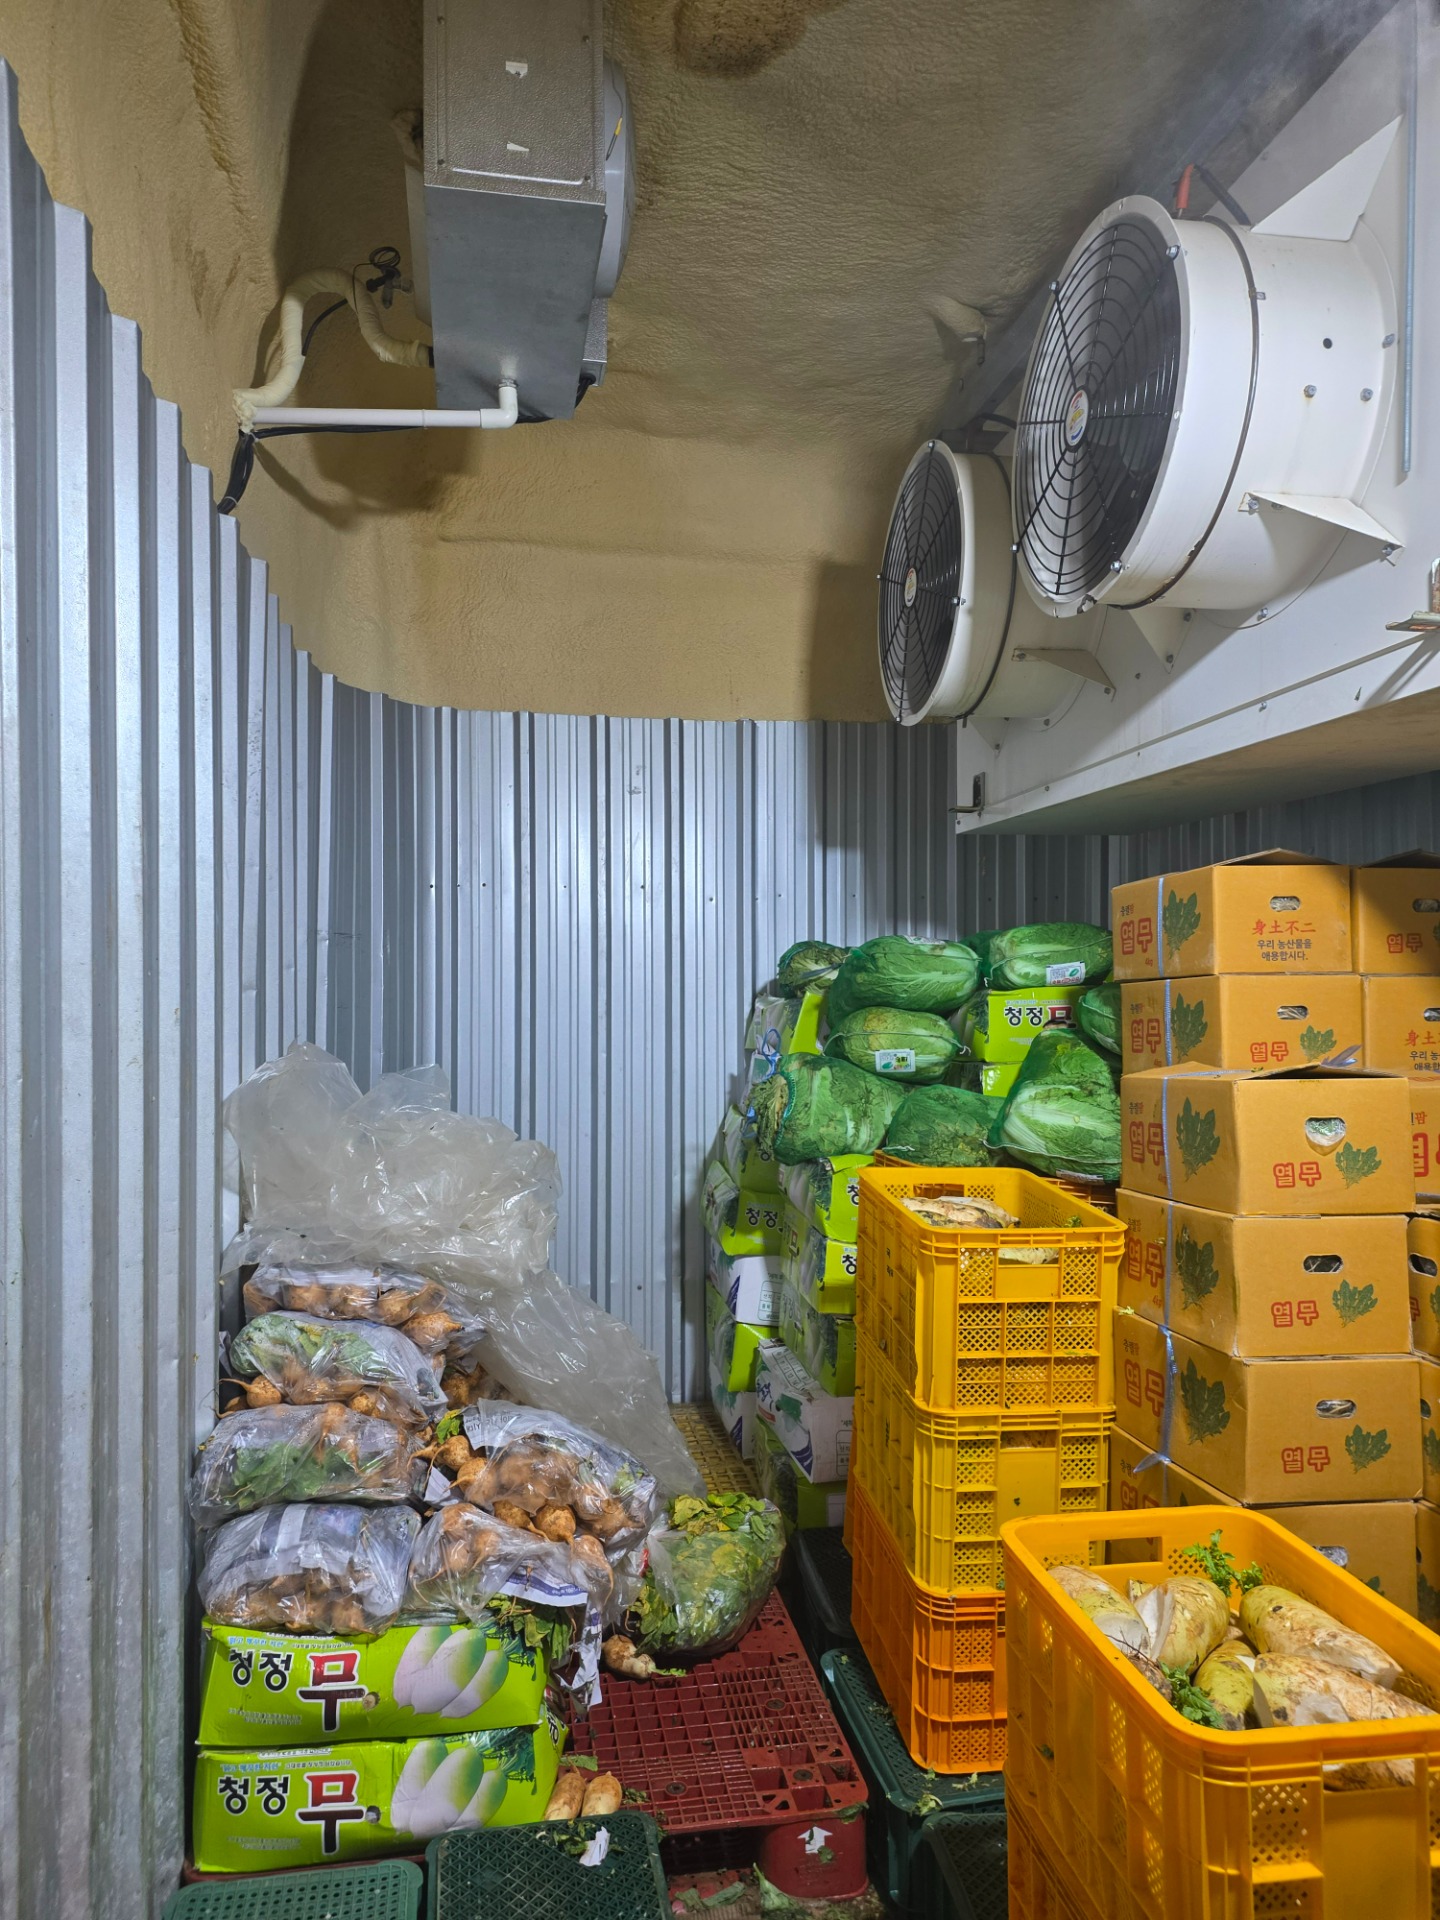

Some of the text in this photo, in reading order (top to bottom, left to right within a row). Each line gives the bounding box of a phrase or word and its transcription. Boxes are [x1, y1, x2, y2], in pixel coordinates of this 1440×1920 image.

[1121, 917, 1153, 955] 열무
[1252, 919, 1316, 936] 身土不二
[1257, 938, 1313, 950] 우리 농산물을
[1261, 950, 1309, 961] 애용합시다.
[1387, 933, 1424, 954] 열무
[1004, 1006, 1043, 1026] 청정
[1131, 1018, 1162, 1054] 열무
[1404, 1029, 1440, 1046] 身土
[1250, 1041, 1290, 1063] 열무
[1409, 1050, 1427, 1061] 우리
[1129, 1121, 1166, 1167] 열무
[1273, 1161, 1322, 1189] 열무
[745, 1207, 778, 1229] 청정
[1127, 1236, 1165, 1289] 열무
[1271, 1300, 1320, 1328] 열무
[1124, 1358, 1165, 1418] 열무
[1281, 1445, 1331, 1474] 열무
[229, 1648, 368, 1733] 청정 무
[218, 1771, 366, 1855] 청정 무
